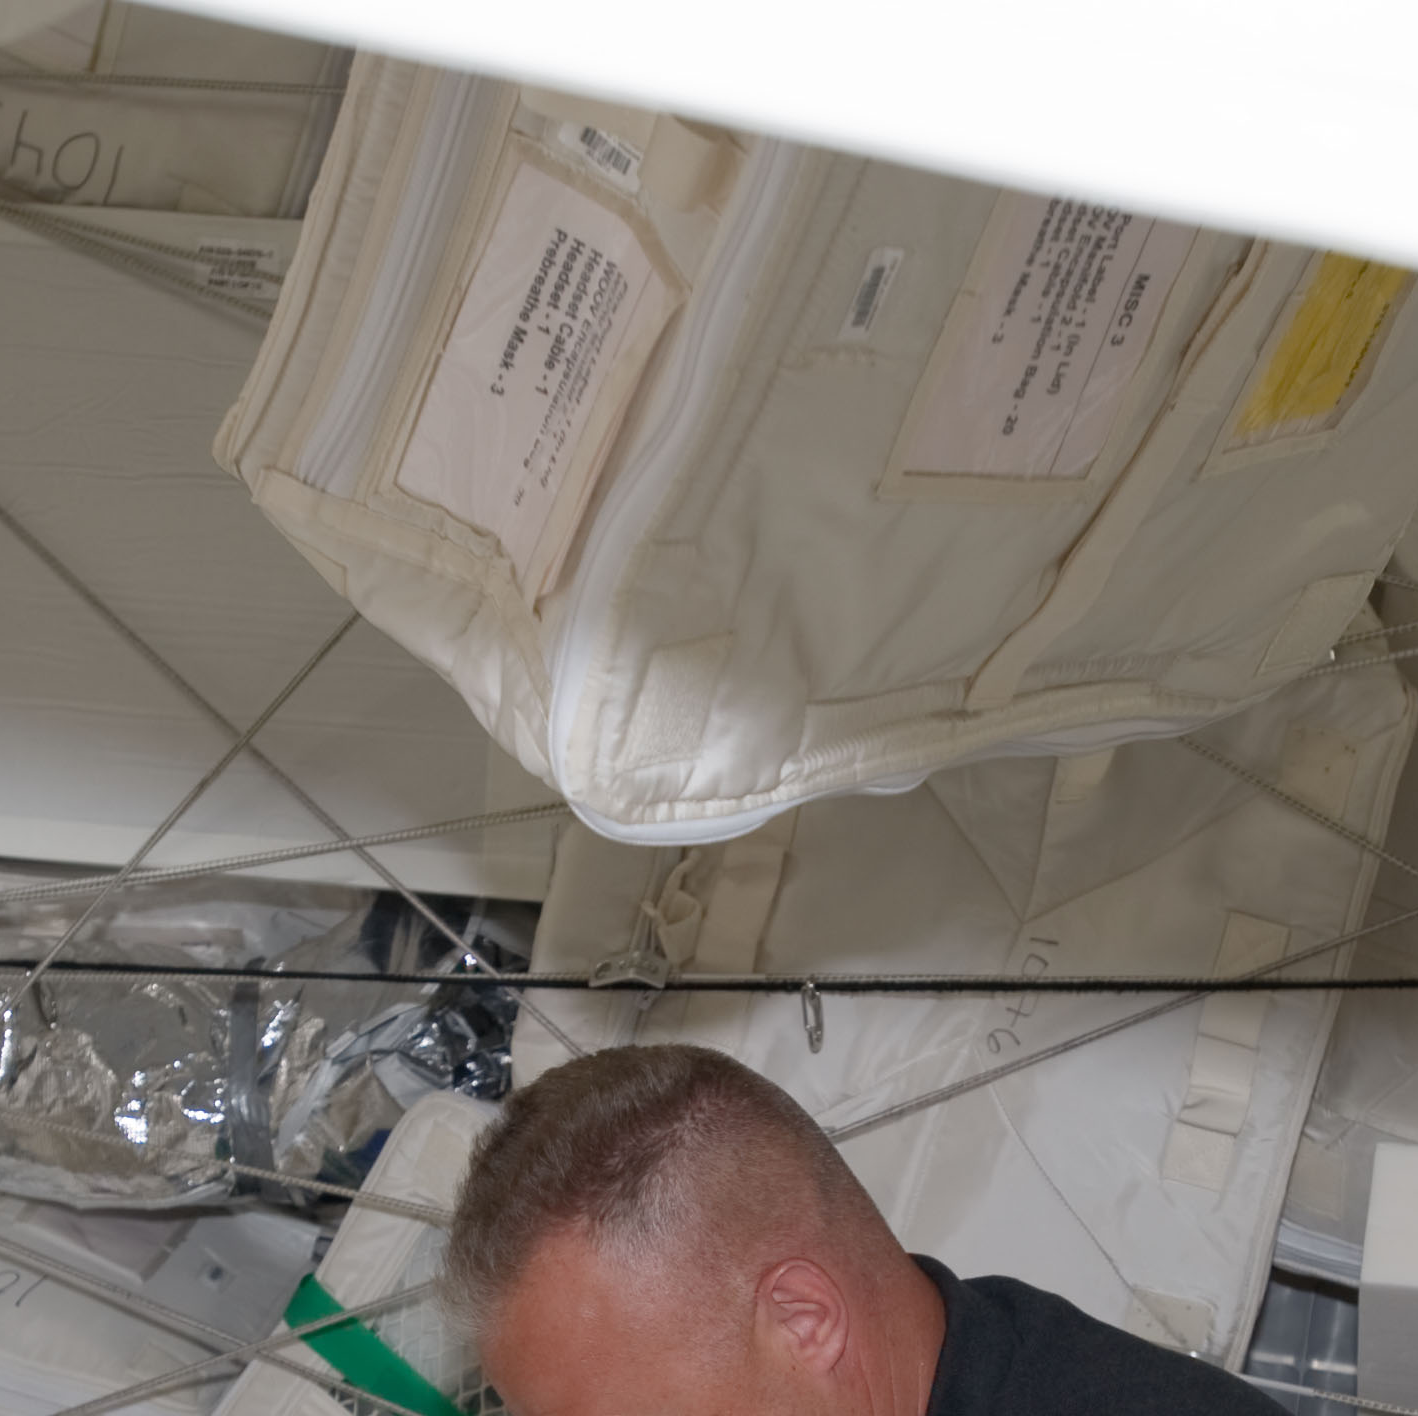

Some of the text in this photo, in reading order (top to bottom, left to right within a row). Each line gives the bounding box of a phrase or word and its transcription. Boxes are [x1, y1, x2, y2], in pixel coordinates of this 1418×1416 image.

[518, 227, 568, 323] Prebreathe
[547, 237, 586, 310] Headset
[565, 248, 603, 321] Headset
[1032, 234, 1092, 360] Encapsulation
[1085, 254, 1114, 303] Label
[537, 324, 551, 335] 1
[1110, 273, 1151, 346] MISC 3
[499, 323, 528, 370] Mask
[544, 322, 574, 371] Cable
[490, 383, 505, 396] 3
[535, 385, 549, 396] 1
[1014, 365, 1038, 399] Bag
